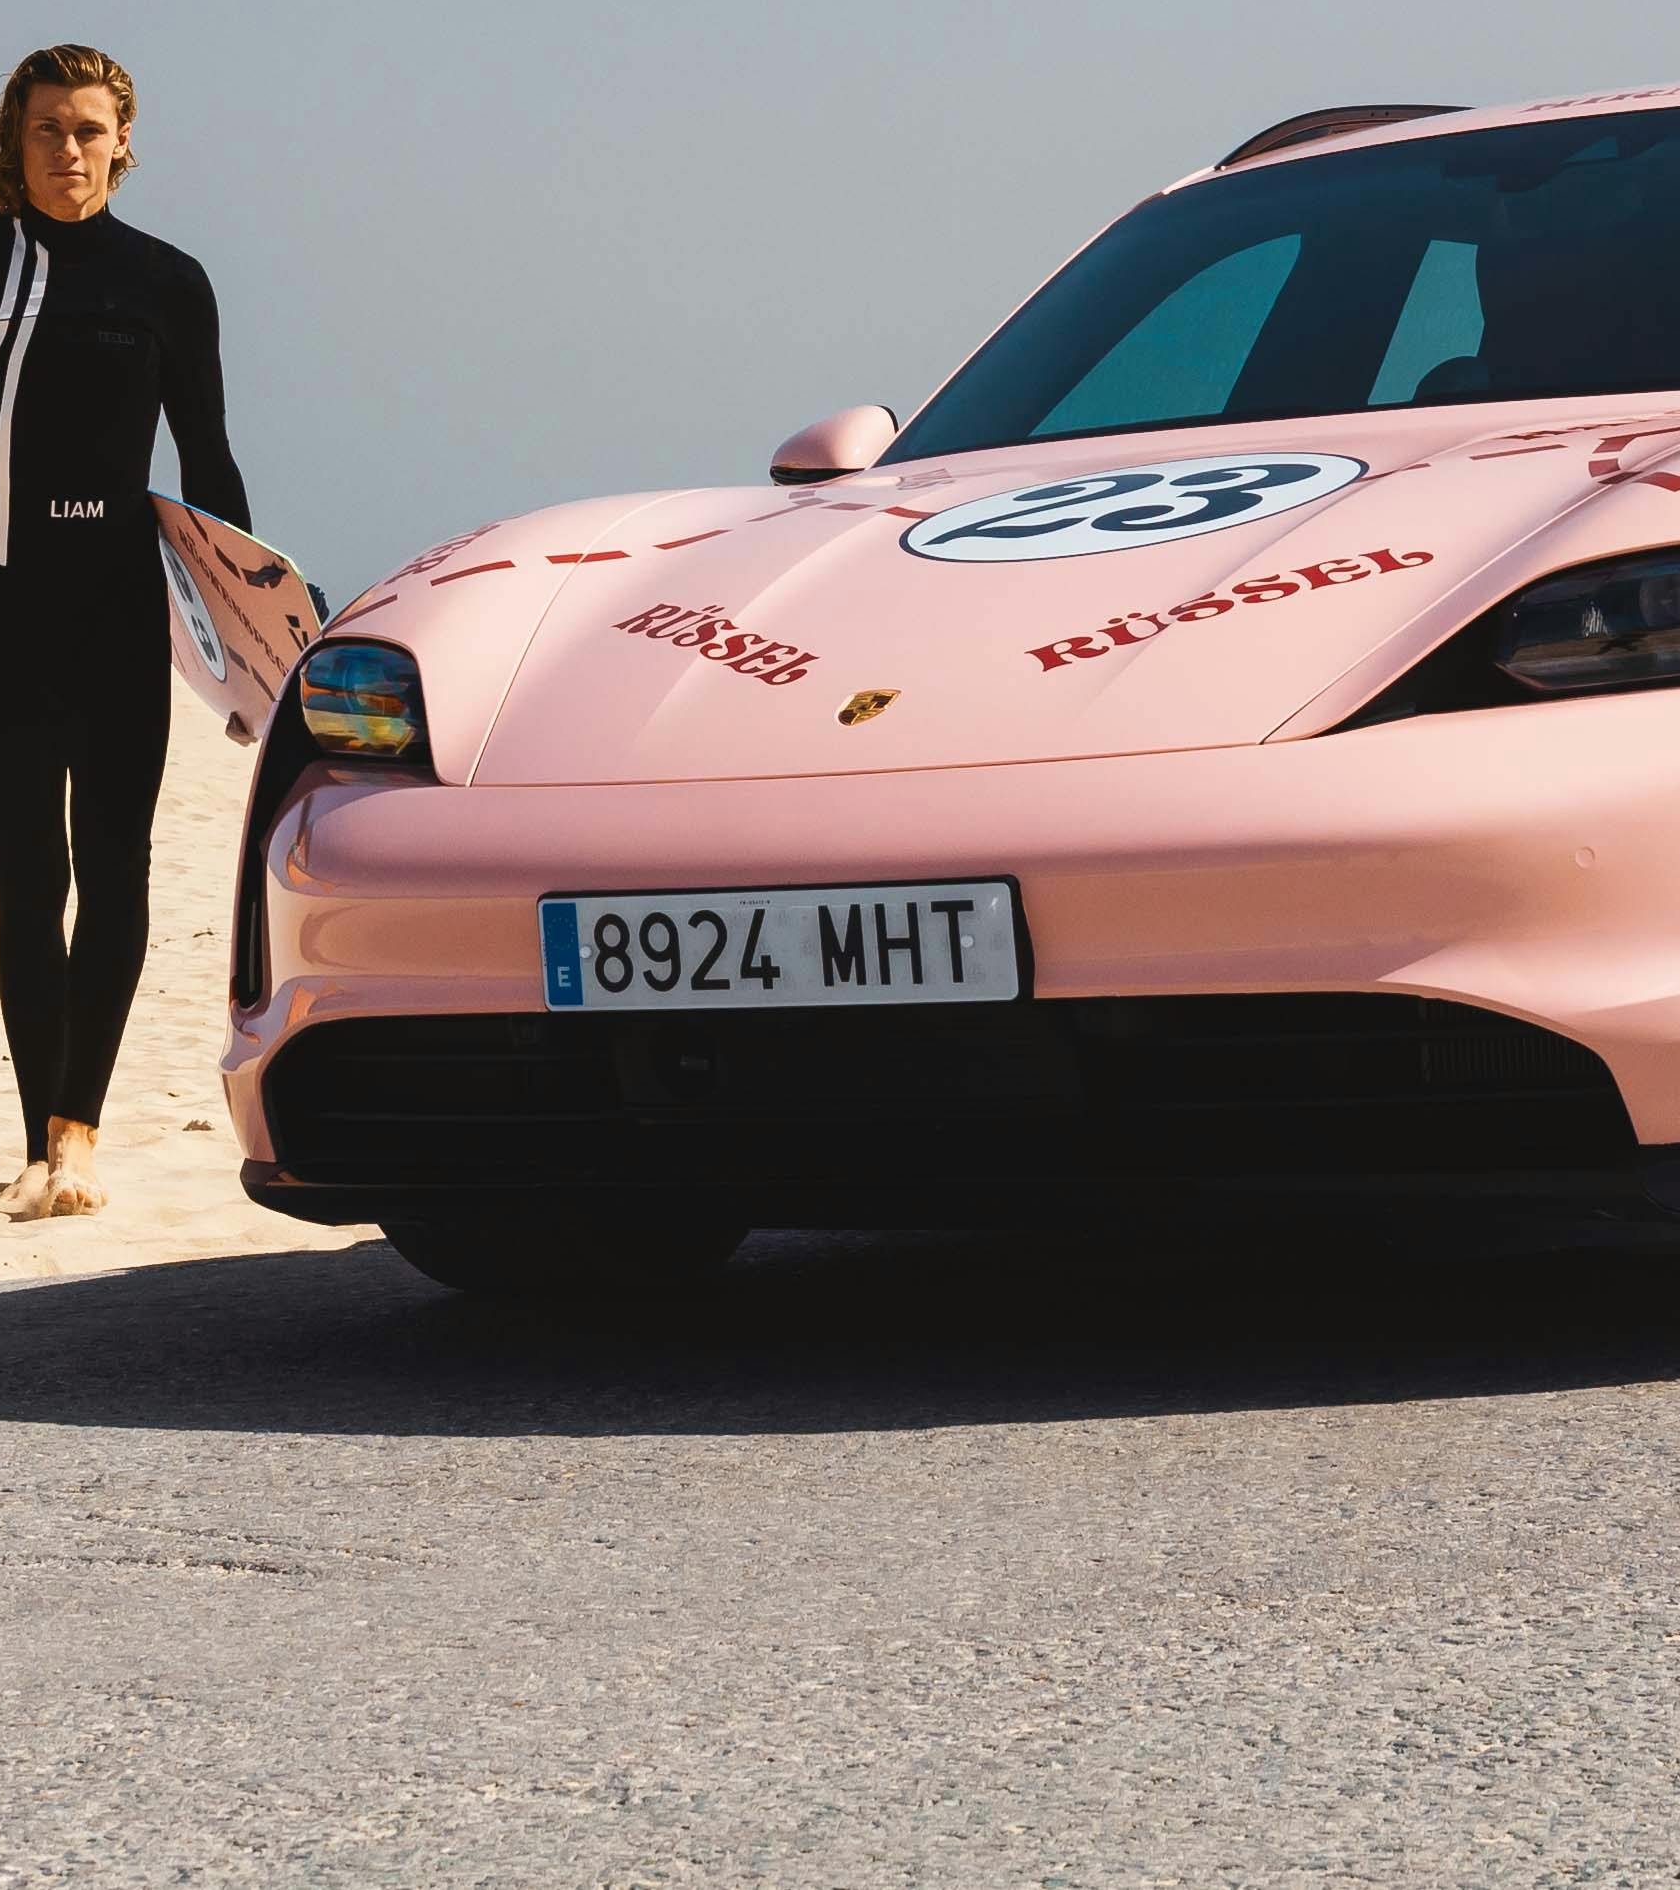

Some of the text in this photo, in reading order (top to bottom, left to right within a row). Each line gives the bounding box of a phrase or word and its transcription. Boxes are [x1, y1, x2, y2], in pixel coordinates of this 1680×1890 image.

[50, 499, 105, 519] LIAM
[922, 463, 1322, 547] 23
[177, 525, 292, 677] RÜCKENSPEC
[1025, 547, 1434, 673] RÜSSEL
[612, 602, 822, 687] RÜSSEL
[557, 967, 571, 989] E
[592, 899, 975, 994] 8924 MHT
